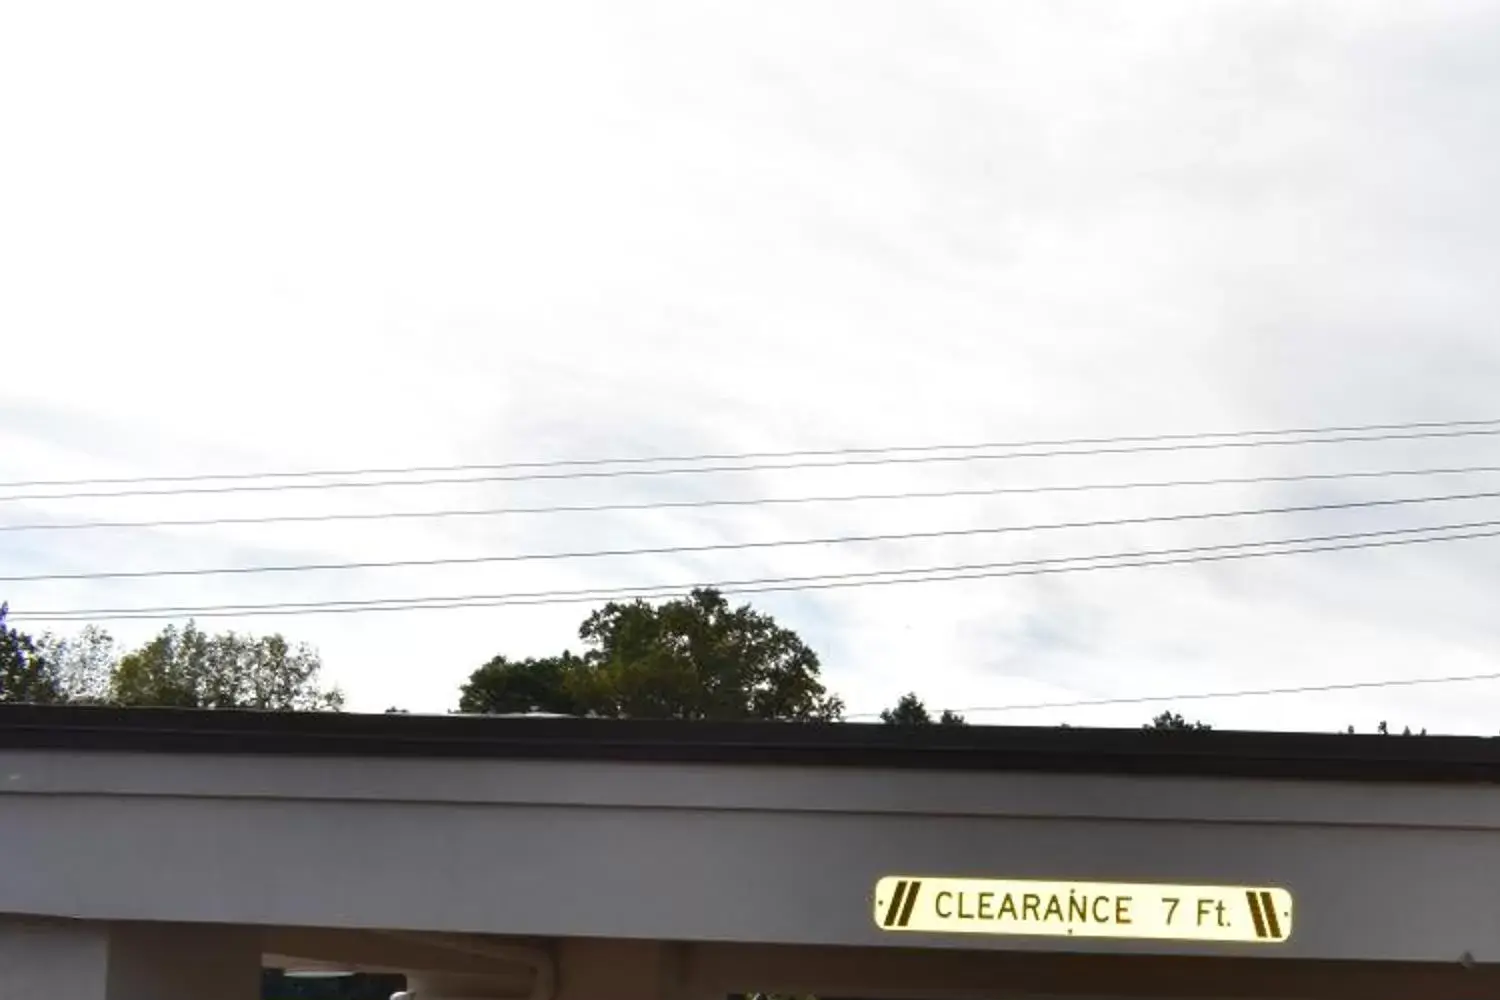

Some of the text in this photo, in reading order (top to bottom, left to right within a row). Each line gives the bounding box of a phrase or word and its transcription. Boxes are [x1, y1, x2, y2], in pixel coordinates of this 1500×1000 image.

[934, 890, 1231, 927] CLEARANCE 7 Ft.
